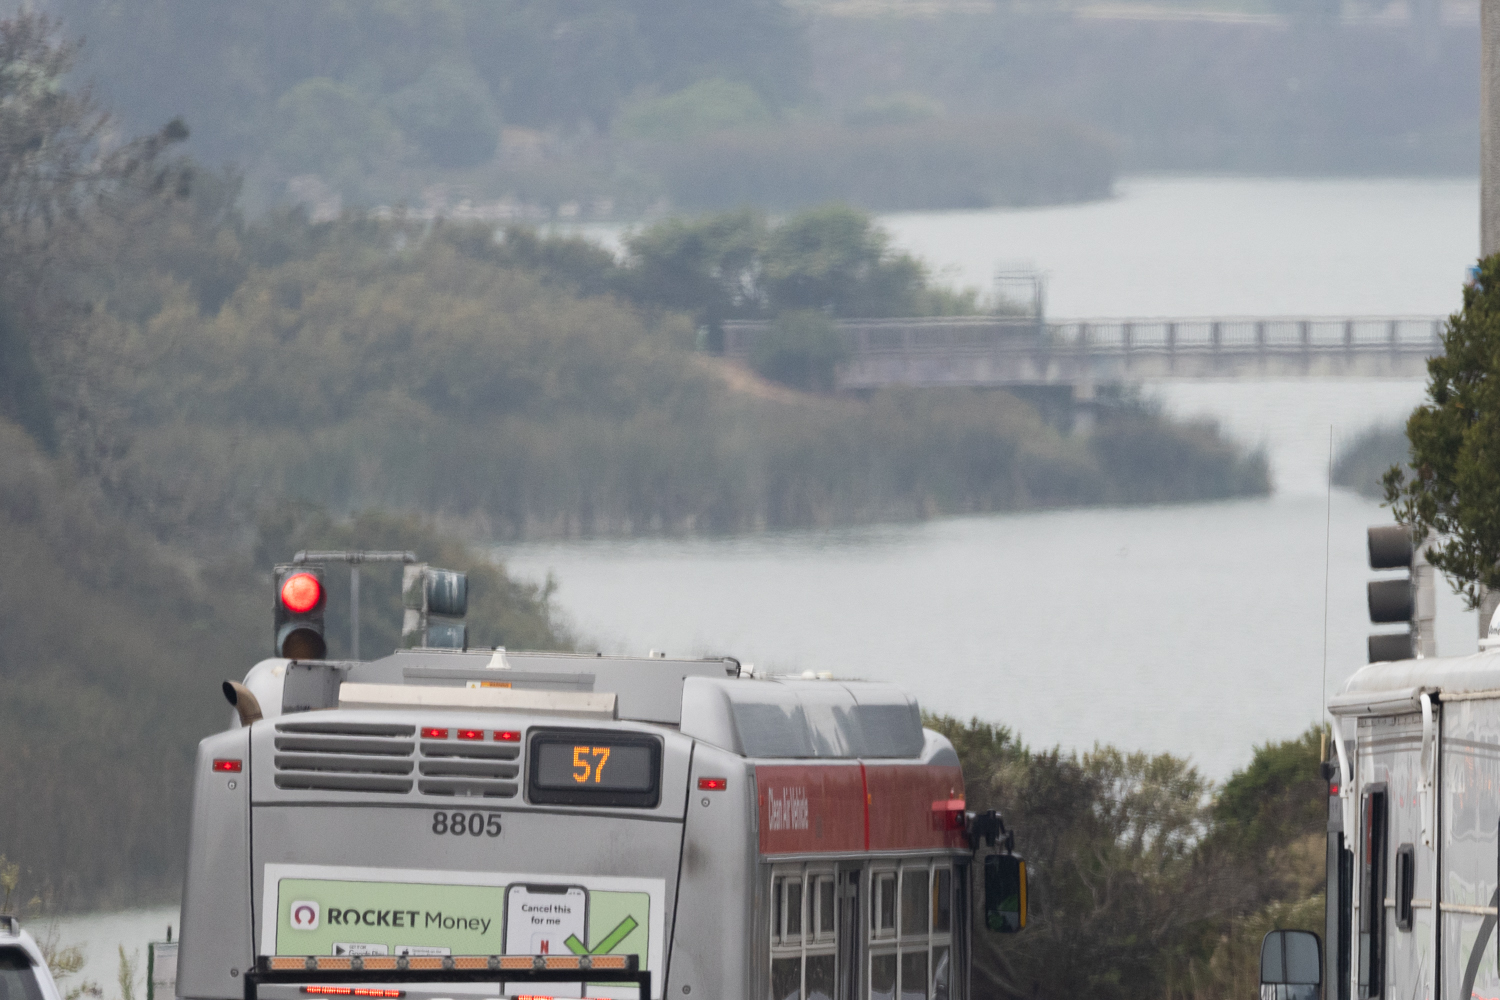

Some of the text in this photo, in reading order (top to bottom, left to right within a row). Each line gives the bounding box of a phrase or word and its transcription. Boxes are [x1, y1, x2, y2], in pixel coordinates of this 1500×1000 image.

[573, 746, 610, 783] 57
[768, 787, 782, 830] Clean
[790, 786, 808, 830] Vehicle
[432, 811, 502, 838] 8805
[327, 908, 491, 935] ROCKET Money
[521, 904, 572, 914] Cancel this
[531, 916, 561, 925] for me
